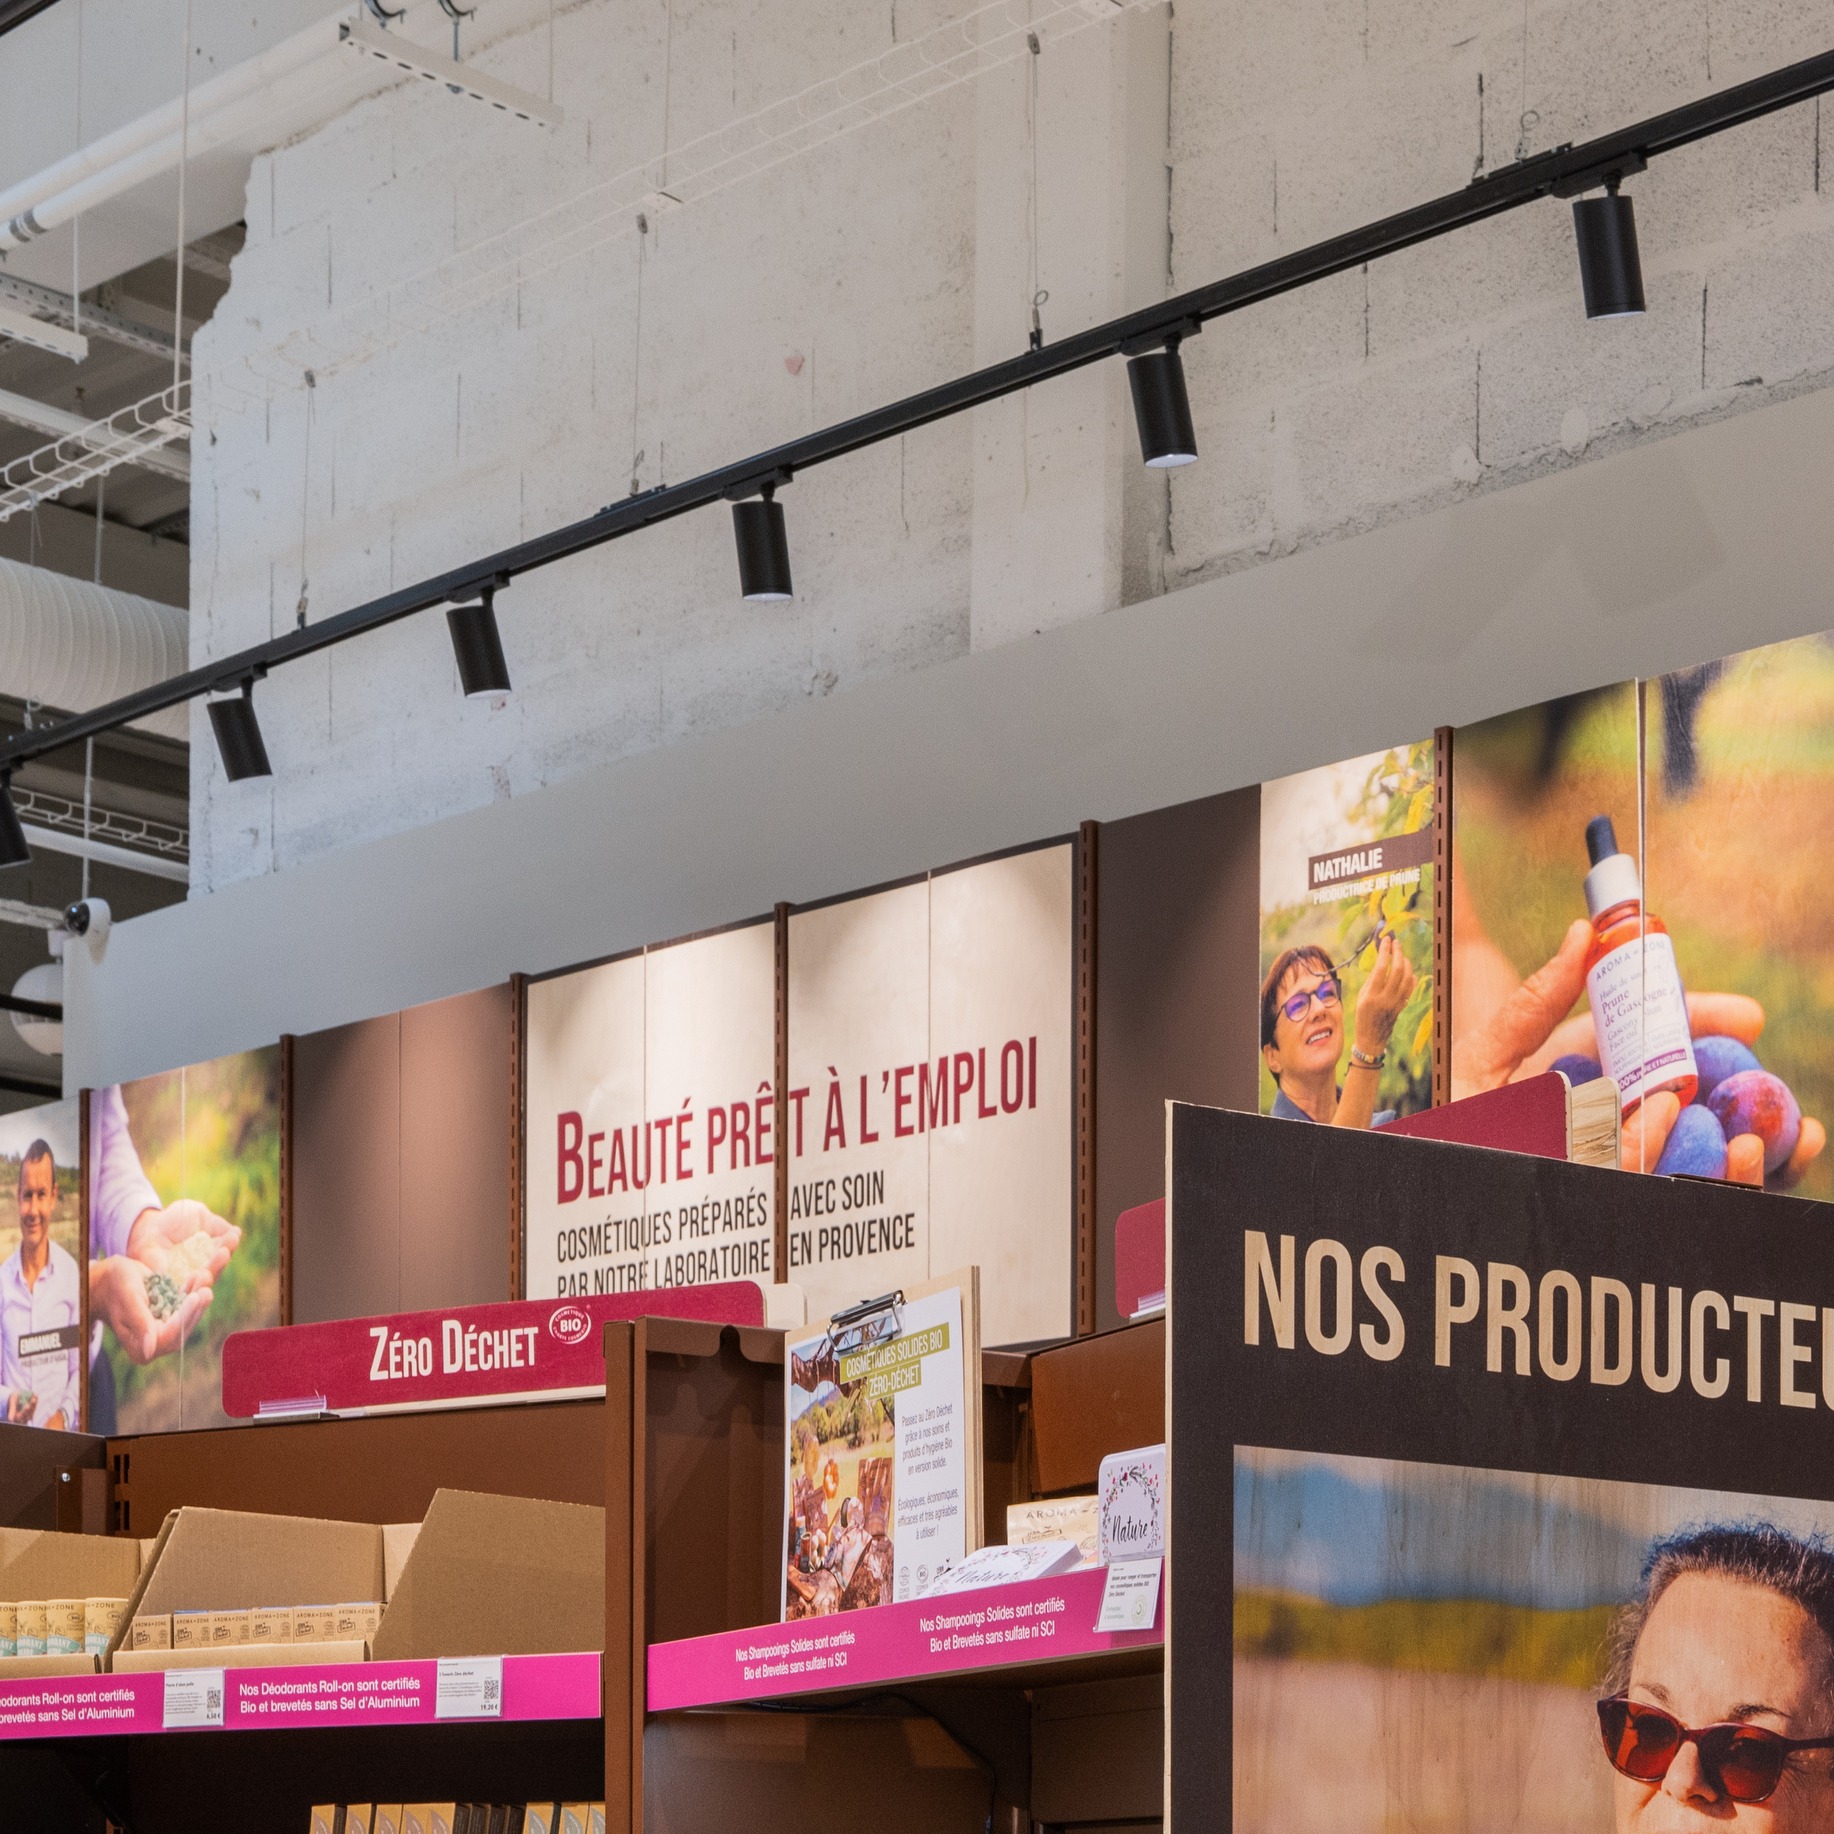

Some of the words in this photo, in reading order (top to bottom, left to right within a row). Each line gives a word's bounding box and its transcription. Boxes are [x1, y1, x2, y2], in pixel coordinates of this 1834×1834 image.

[1313, 847, 1383, 883] NATHALIE
[1313, 879, 1375, 905] PRODUCTRICE
[1375, 875, 1388, 890] DE
[1390, 868, 1420, 887] PRUNE
[557, 1096, 693, 1206] BEAUTÉ
[708, 1080, 809, 1175] PRÊT
[823, 1066, 846, 1152] À
[860, 1036, 1037, 1145] L'EMPLOI
[557, 1211, 672, 1263] COSMÉTIQUES
[679, 1187, 767, 1240] PRÉPARÉS
[790, 1179, 836, 1220] AVEC
[842, 1170, 884, 1210] SOIN
[557, 1273, 588, 1299] PAR
[594, 1262, 650, 1294] NOTRE
[655, 1238, 770, 1290] LABORATOIRE
[790, 1232, 811, 1267] EN
[818, 1213, 915, 1263] PROVENCE
[1244, 1230, 1406, 1362] NOS
[560, 1318, 582, 1333] BIO
[20, 1333, 61, 1355] EMMANUEL
[369, 1325, 432, 1381] ZÉRO
[442, 1319, 539, 1374] DÉCHET
[846, 1346, 896, 1378] COSMÉTIQUES
[897, 1334, 929, 1361] SOLIDES
[930, 1329, 943, 1351] BIO
[869, 1364, 920, 1397] ZÉRO-DÉCHET
[1112, 1515, 1148, 1545] Nature
[920, 1617, 934, 1633] Nos
[935, 1609, 985, 1632] Shampooings
[986, 1606, 1013, 1623] Solides
[1015, 1603, 1033, 1619] sont
[1034, 1597, 1065, 1616] certifiés
[735, 1647, 748, 1663] Nos
[749, 1641, 790, 1661] Shampooings
[790, 1637, 814, 1653] Solides
[815, 1635, 829, 1649] sont
[830, 1630, 856, 1647] certifiés
[930, 1637, 942, 1653] Bio
[943, 1636, 951, 1649] et
[952, 1629, 984, 1648] Brevetés
[985, 1630, 1003, 1645] sans
[1004, 1625, 1030, 1642] sulfate
[1031, 1624, 1039, 1637] ni
[1040, 1620, 1055, 1636] SCI
[744, 1666, 755, 1681] Bio
[755, 1666, 762, 1678] et
[762, 1659, 789, 1678] Brevetés
[790, 1661, 804, 1674] sans
[805, 1656, 827, 1672] sulfate
[827, 1654, 834, 1668] ni
[835, 1651, 847, 1667] SCI
[239, 1683, 259, 1696] Nos
[261, 1680, 317, 1696] Déodorants
[319, 1679, 354, 1693] Roll-on
[356, 1678, 378, 1692] sont
[380, 1677, 420, 1691] certifiés
[240, 1700, 256, 1713] Bio
[258, 1701, 268, 1712] et
[270, 1698, 313, 1712] brevetés
[314, 1699, 338, 1711] sans
[339, 1696, 356, 1710] Sel
[358, 1695, 420, 1709] d'Aluminium
